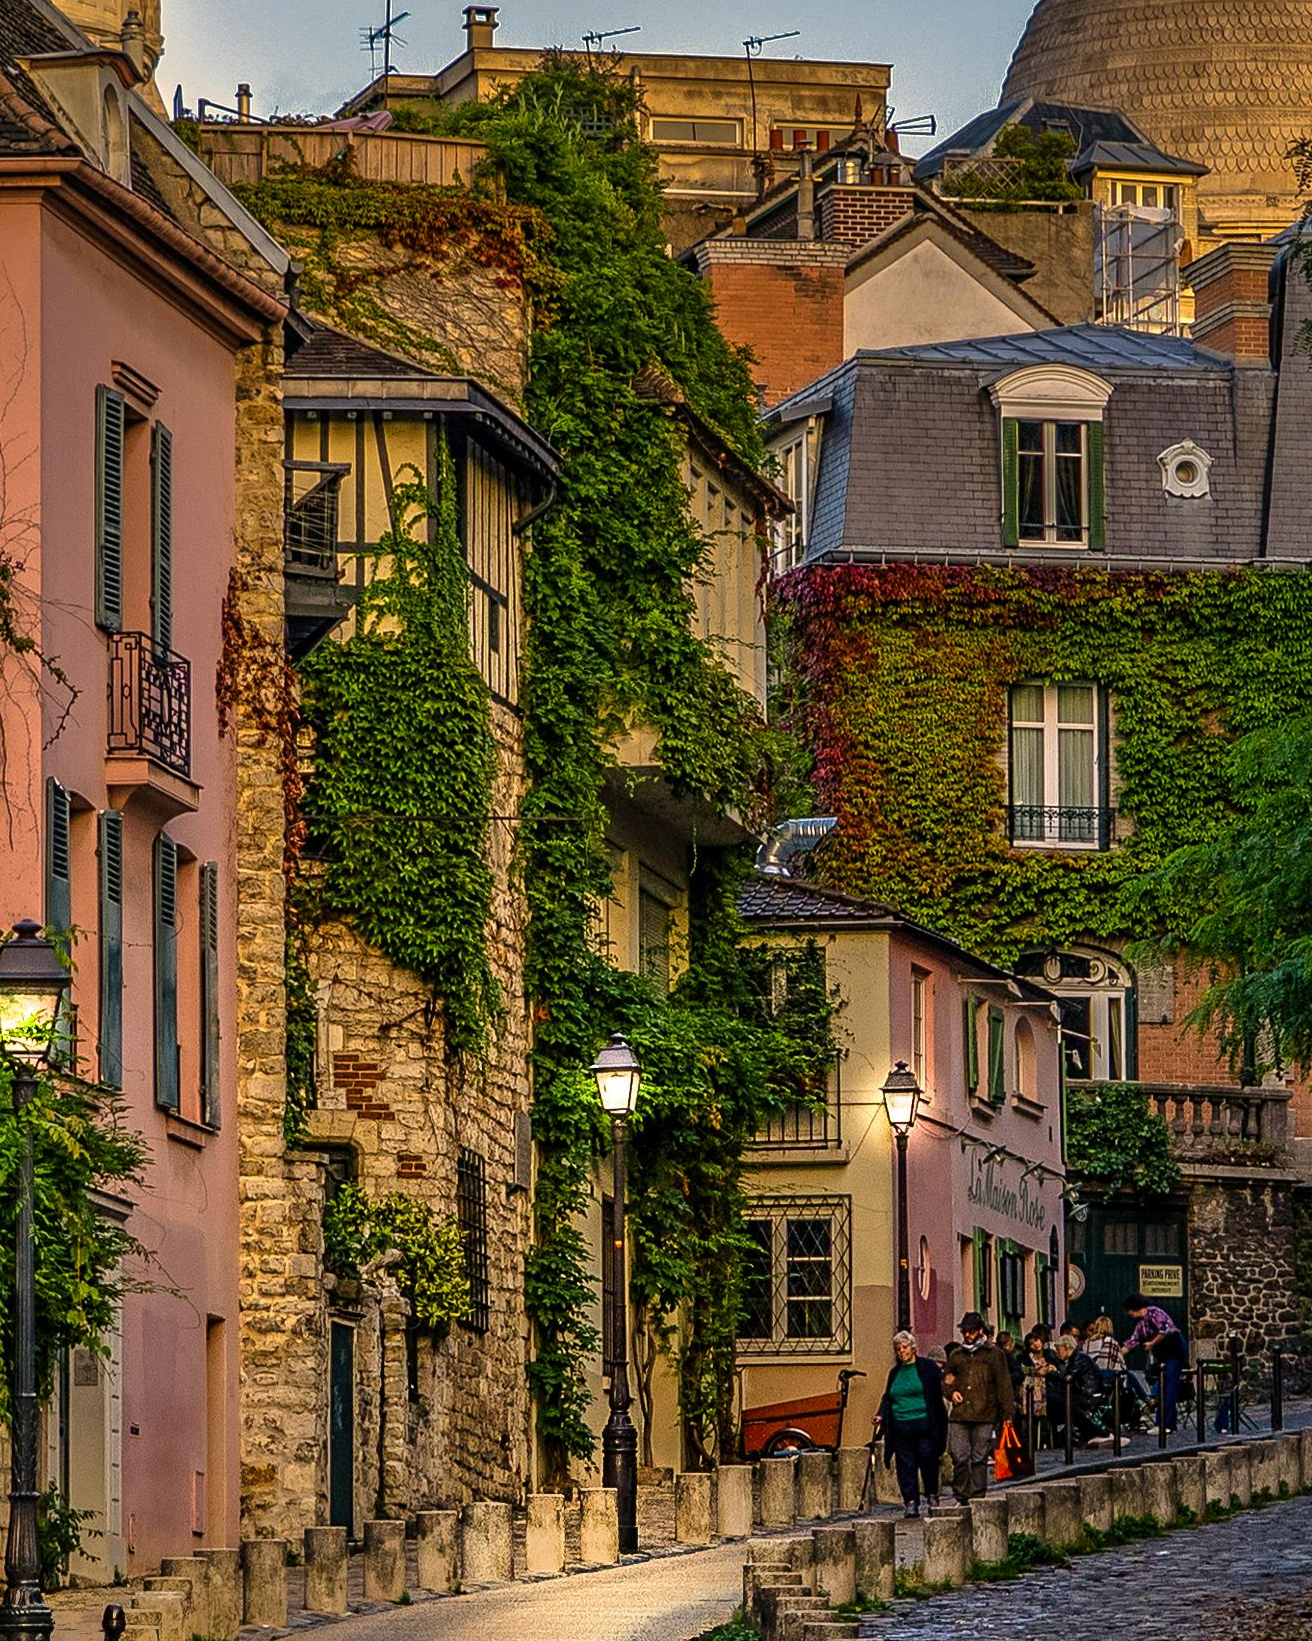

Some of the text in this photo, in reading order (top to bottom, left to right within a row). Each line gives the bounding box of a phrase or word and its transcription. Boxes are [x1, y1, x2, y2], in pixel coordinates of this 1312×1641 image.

[968, 1147, 1046, 1232] La Maison Rose
